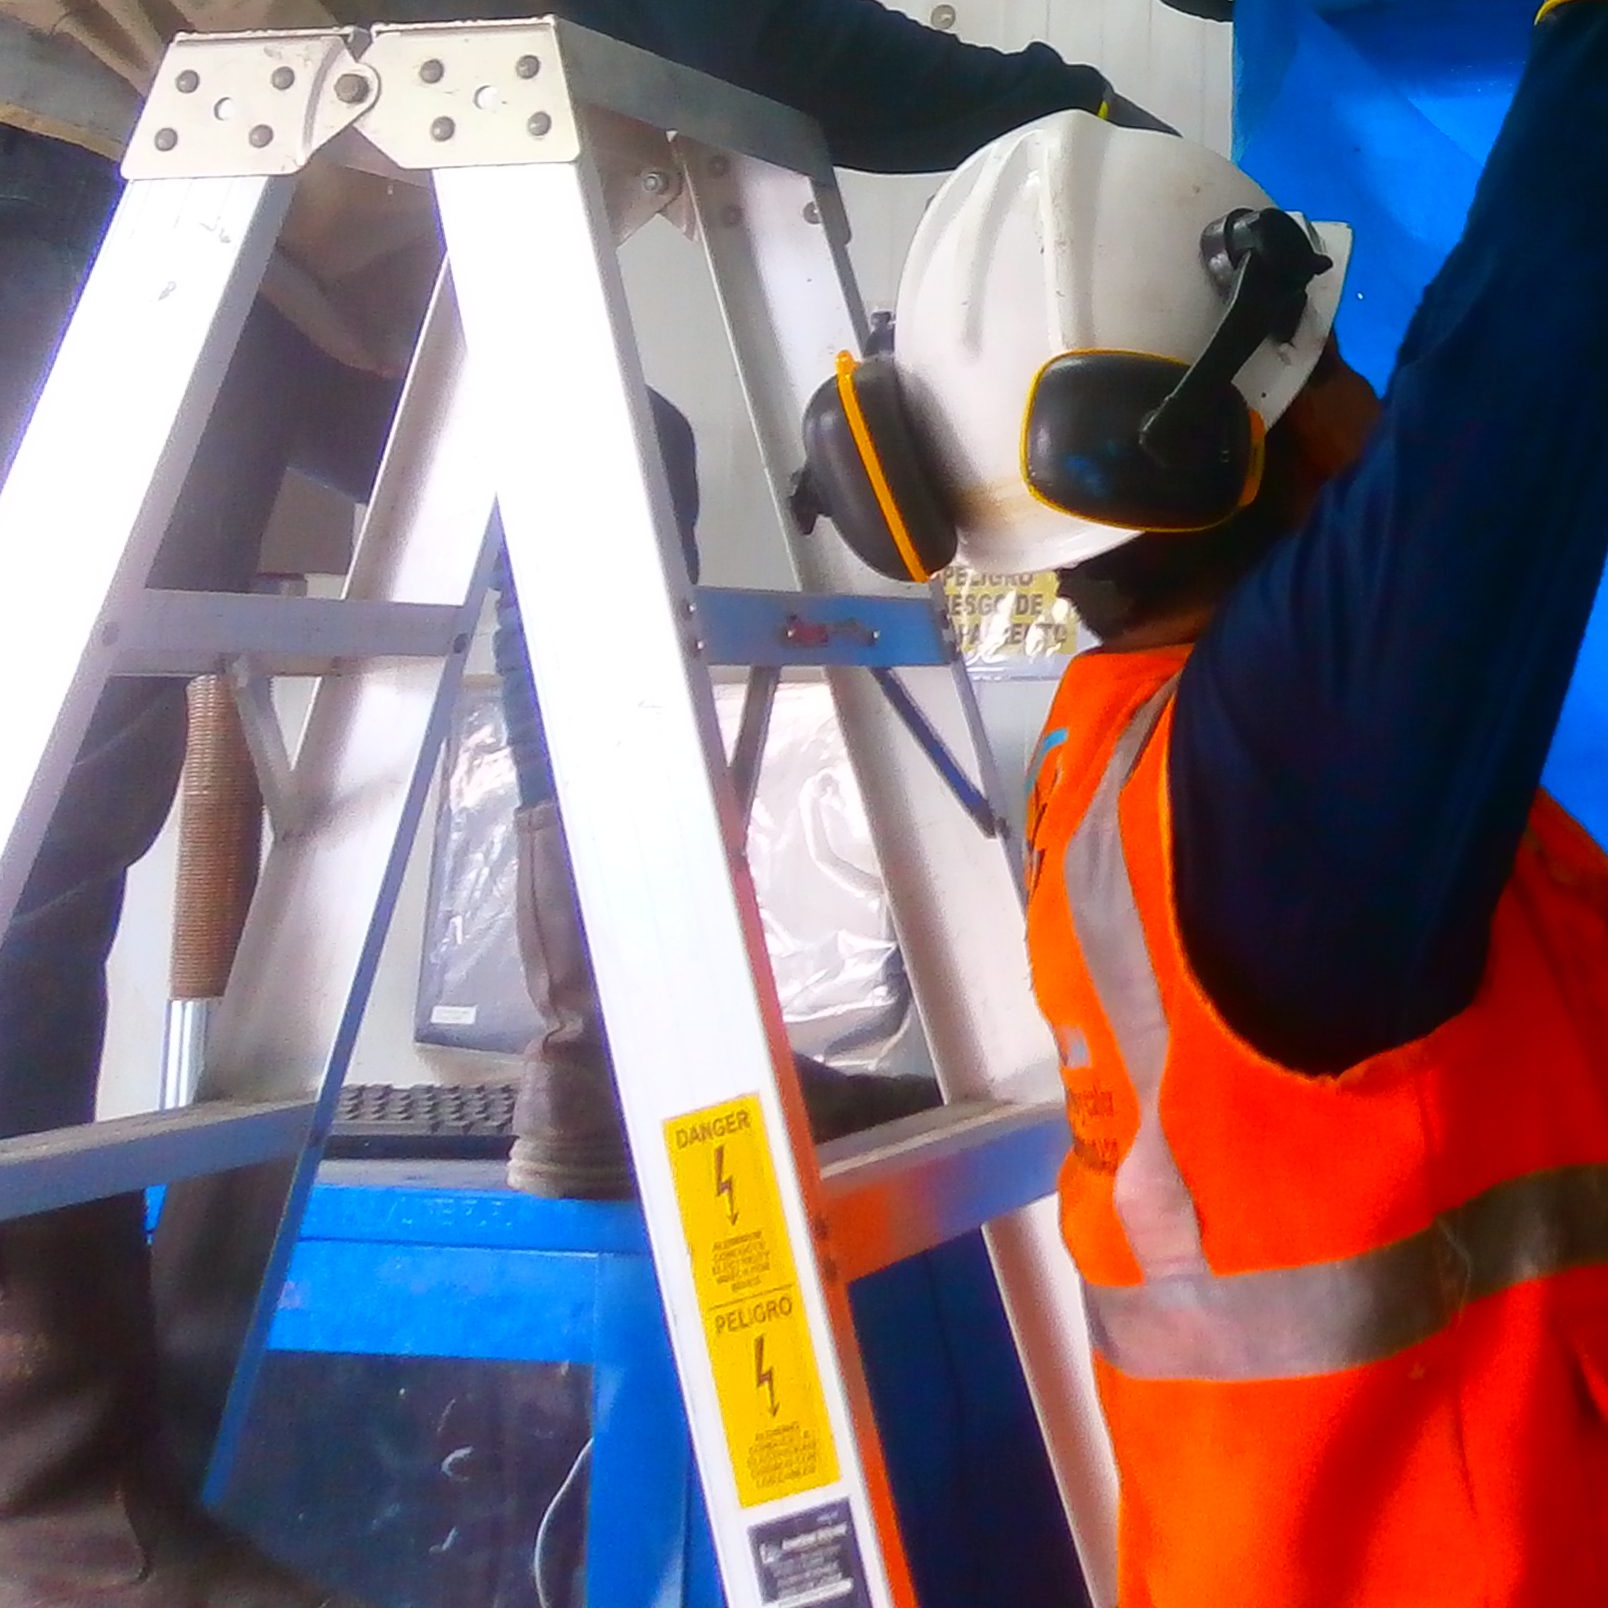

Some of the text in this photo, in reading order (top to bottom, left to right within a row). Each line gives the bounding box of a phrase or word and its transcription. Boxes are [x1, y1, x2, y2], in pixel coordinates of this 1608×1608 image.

[1015, 594, 1043, 615] DE
[676, 1109, 752, 1150] DANGER
[714, 1296, 793, 1335] PELIGRO
